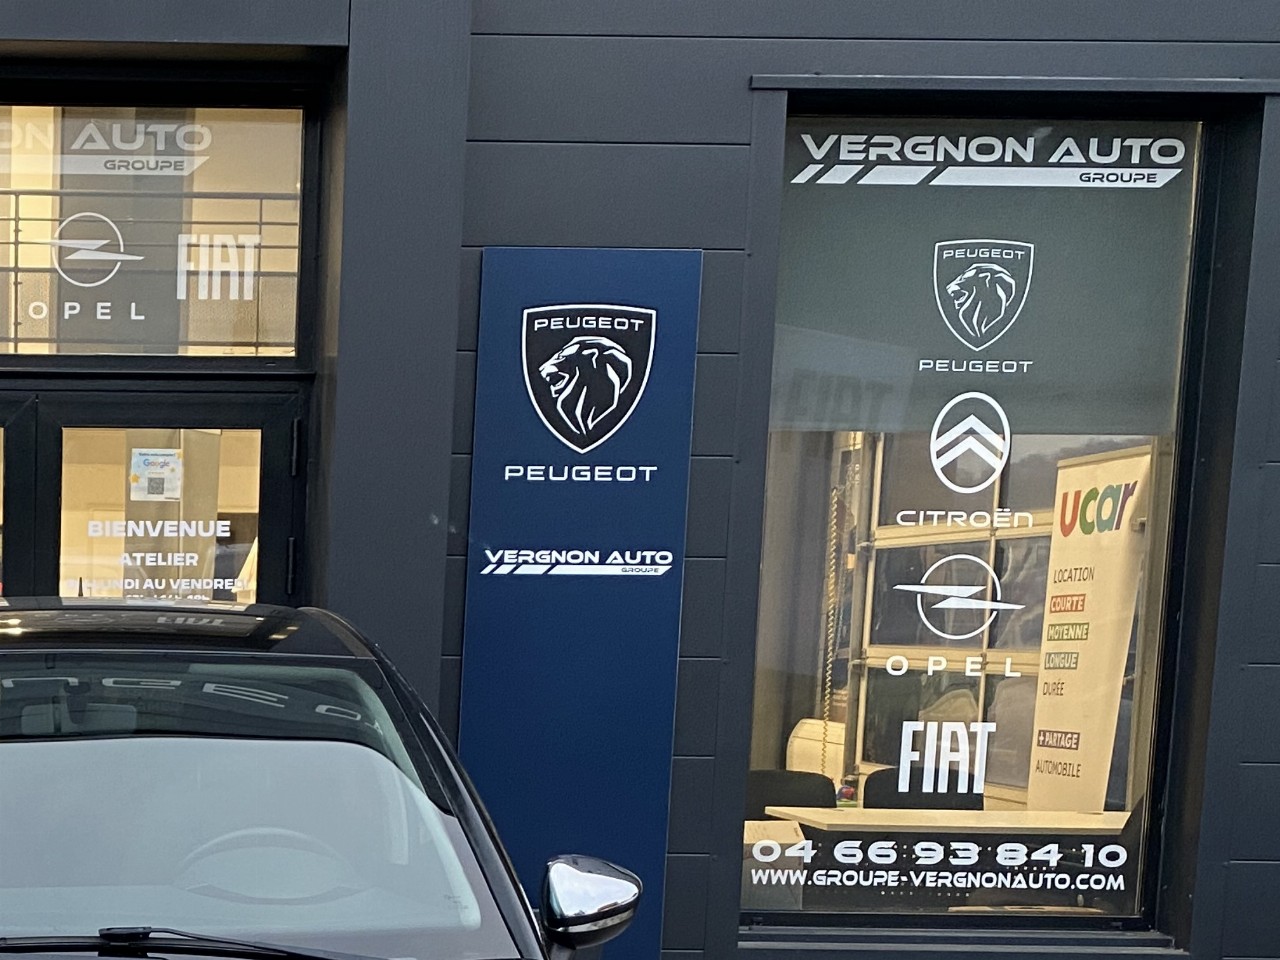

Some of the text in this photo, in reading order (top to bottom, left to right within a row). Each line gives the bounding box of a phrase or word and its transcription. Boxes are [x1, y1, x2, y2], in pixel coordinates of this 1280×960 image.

[71, 122, 212, 152] AUTO
[801, 133, 1186, 164] VERGNON AUTO
[103, 158, 186, 172] GROUPE
[1079, 171, 1158, 184] GROUPE
[942, 248, 1026, 260] PEUGEOT
[176, 233, 262, 301] FIAT
[28, 300, 145, 320] OPEL
[533, 316, 645, 332] PEUGEOT
[919, 359, 1034, 374] PEUGEOT
[504, 465, 658, 482] PEUGEOT
[1060, 480, 1138, 538] ucar
[87, 520, 231, 538] BIENVENUE
[118, 552, 199, 567] ATELIER
[484, 549, 674, 565] VERGNON AUTO
[620, 566, 660, 574] GROUPE
[1053, 566, 1095, 584] LOCATION
[142, 578, 166, 590] AU
[1050, 595, 1085, 611] COURTE
[1047, 624, 1089, 640] MOYENNE
[885, 655, 1022, 678] OPEL
[1045, 653, 1078, 669] LONGUE
[1042, 679, 1065, 696] DURÉE
[898, 720, 997, 794] FIAT
[1035, 760, 1081, 778] AUTOMOBILE
[751, 839, 1129, 868] 04 66 93 84 10
[750, 867, 1126, 892] WWW.GROUPE-VERGNONAUTO.COM
